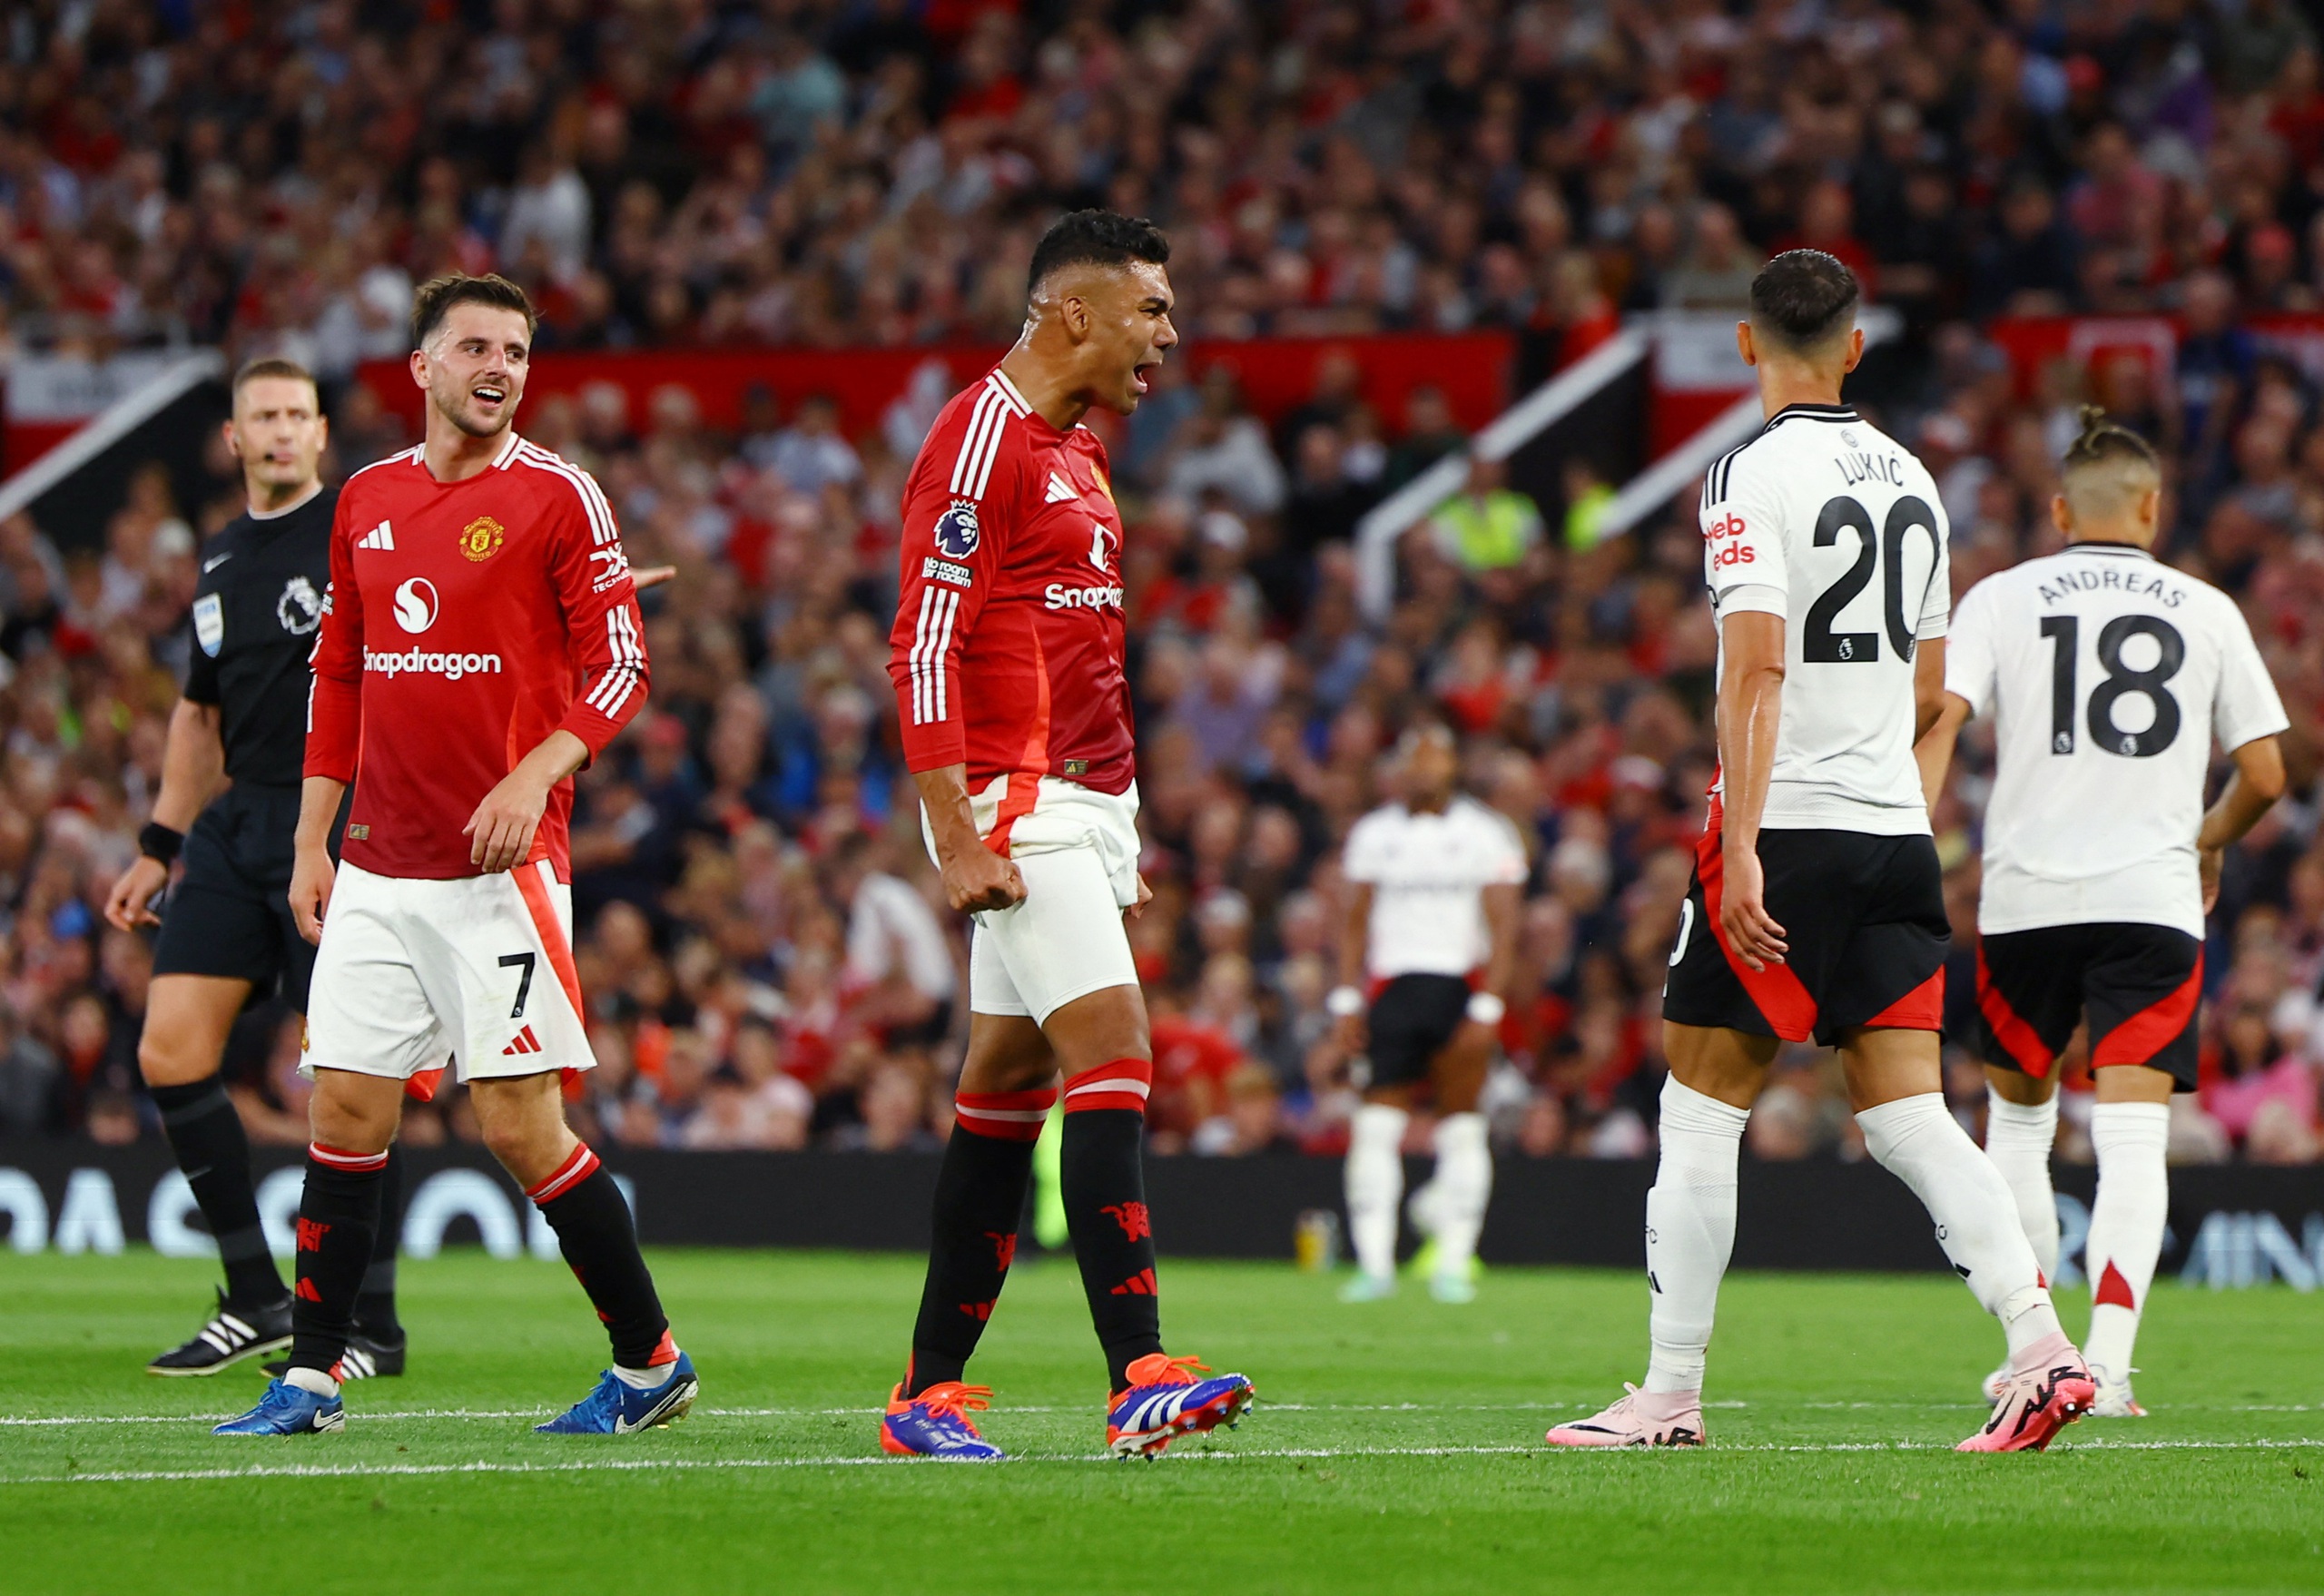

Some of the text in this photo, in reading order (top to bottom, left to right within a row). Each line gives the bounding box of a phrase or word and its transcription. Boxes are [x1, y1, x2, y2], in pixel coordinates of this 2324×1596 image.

[924, 557, 970, 577] No room
[936, 571, 972, 588] racism
[1803, 496, 1941, 664] 20
[2039, 571, 2187, 608] ANDREAS
[2040, 614, 2185, 757] 18
[498, 952, 535, 1019] 7
